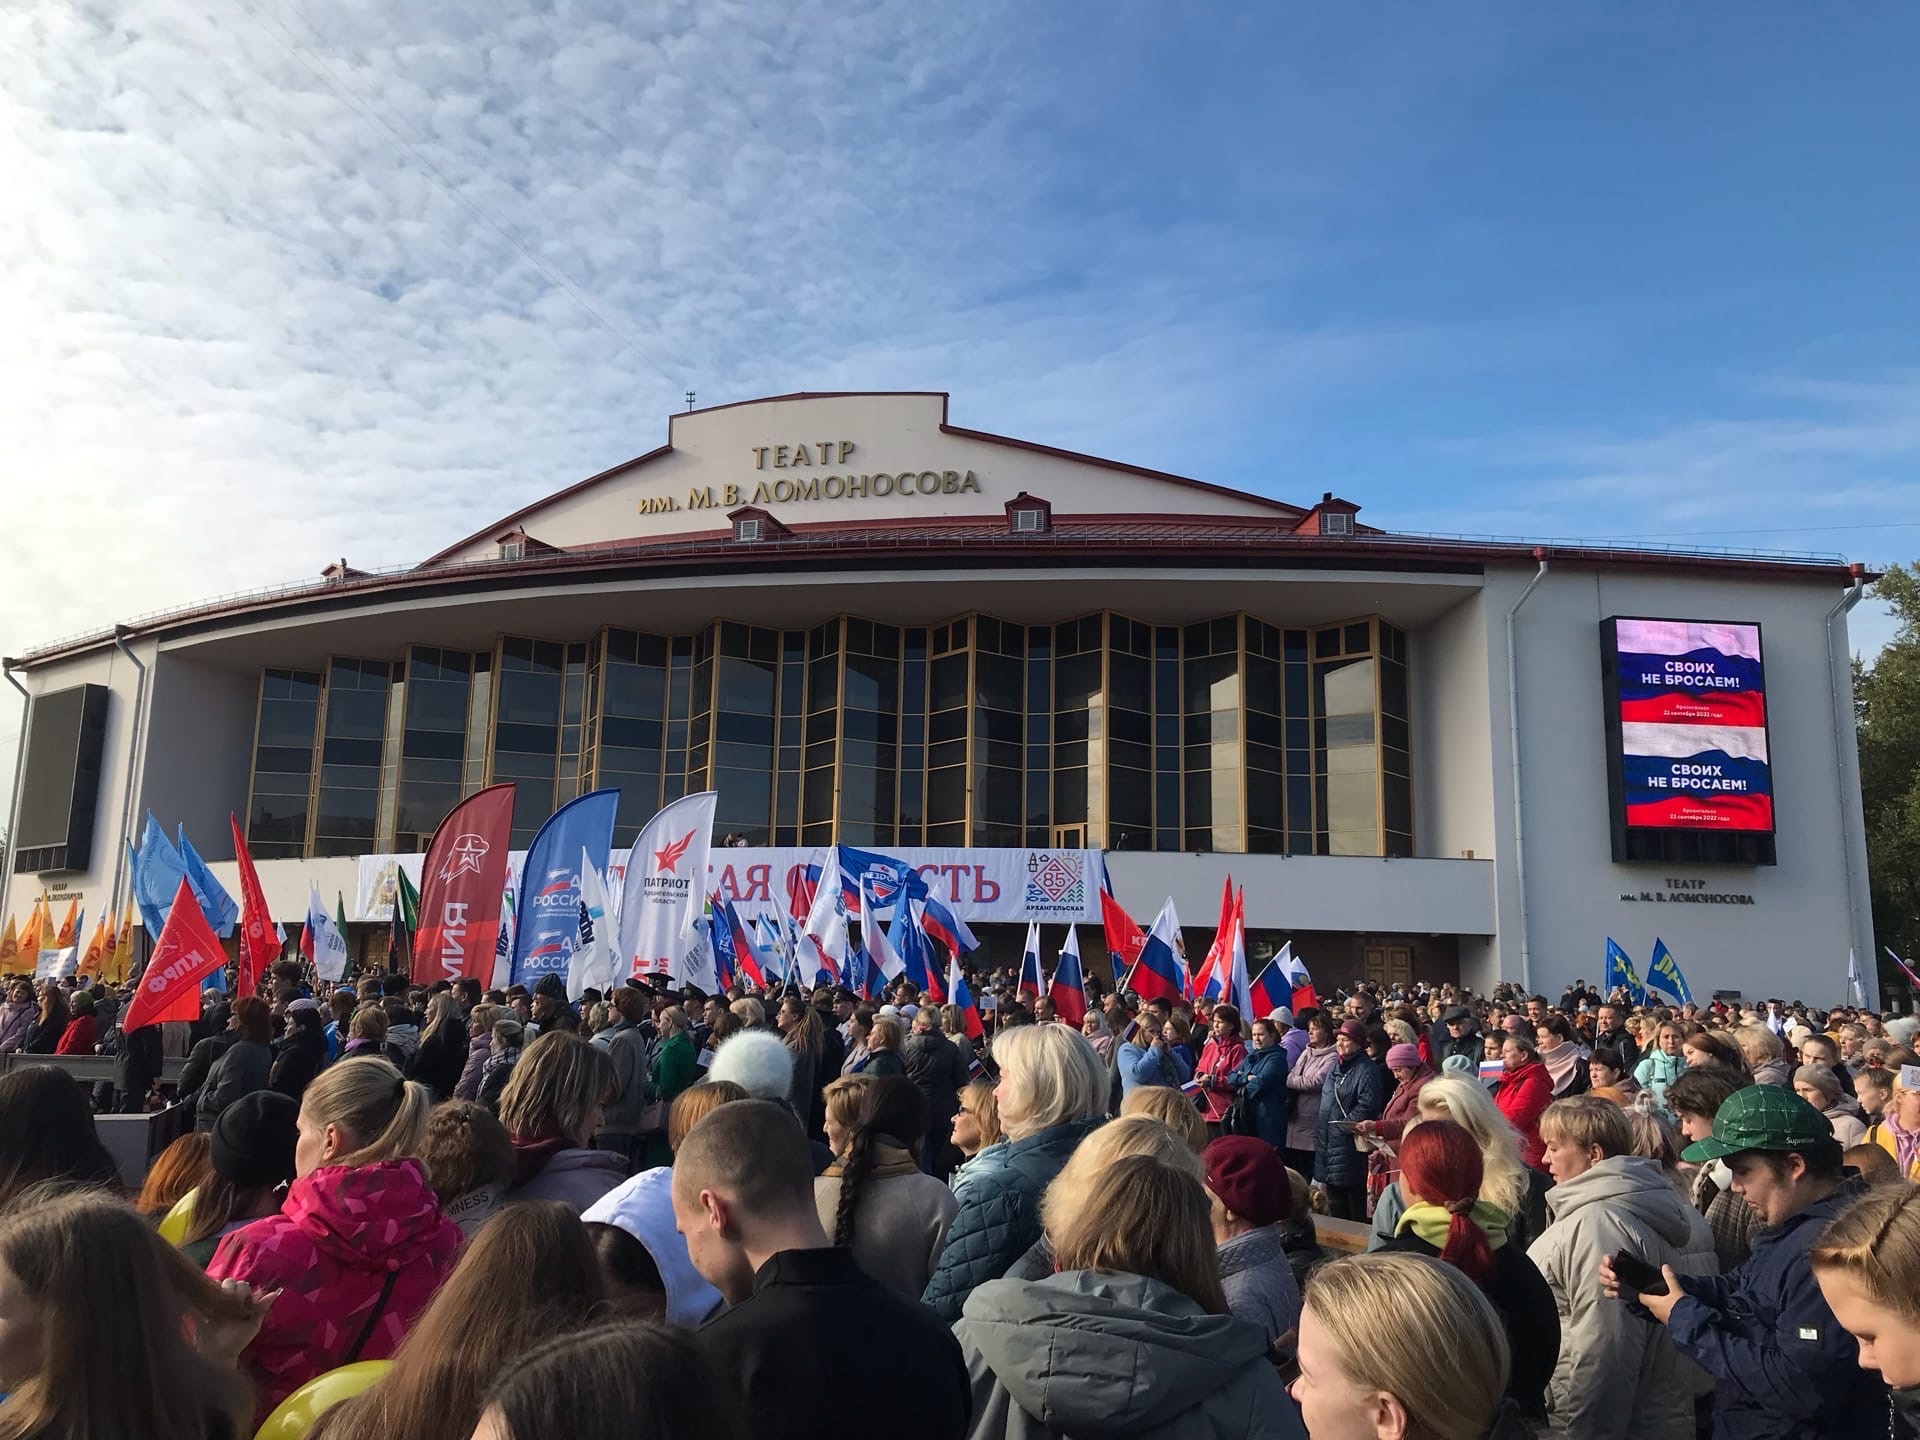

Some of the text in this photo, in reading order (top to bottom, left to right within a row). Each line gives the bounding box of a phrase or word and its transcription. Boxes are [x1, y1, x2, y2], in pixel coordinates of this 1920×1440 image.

[752, 440, 855, 469] ТЕАТР
[750, 470, 981, 505] ЛОМОНОСОВА
[1664, 661, 1715, 673] СВОИХ
[1642, 673, 1740, 688] НЕ БРОСАЕМ!
[1671, 764, 1722, 776] СВОИХ
[1648, 776, 1747, 790] НЕ БРОСАЕМ!
[644, 878, 690, 890] ПАТРИОТ
[1043, 872, 1066, 888] 85
[1665, 878, 1706, 889] ТЕАТР
[533, 893, 581, 908] РОССИ
[1668, 892, 1756, 905] ЛОМОНОСОВА
[523, 956, 572, 969] РОССИ
[448, 1191, 489, 1217] MNESS
